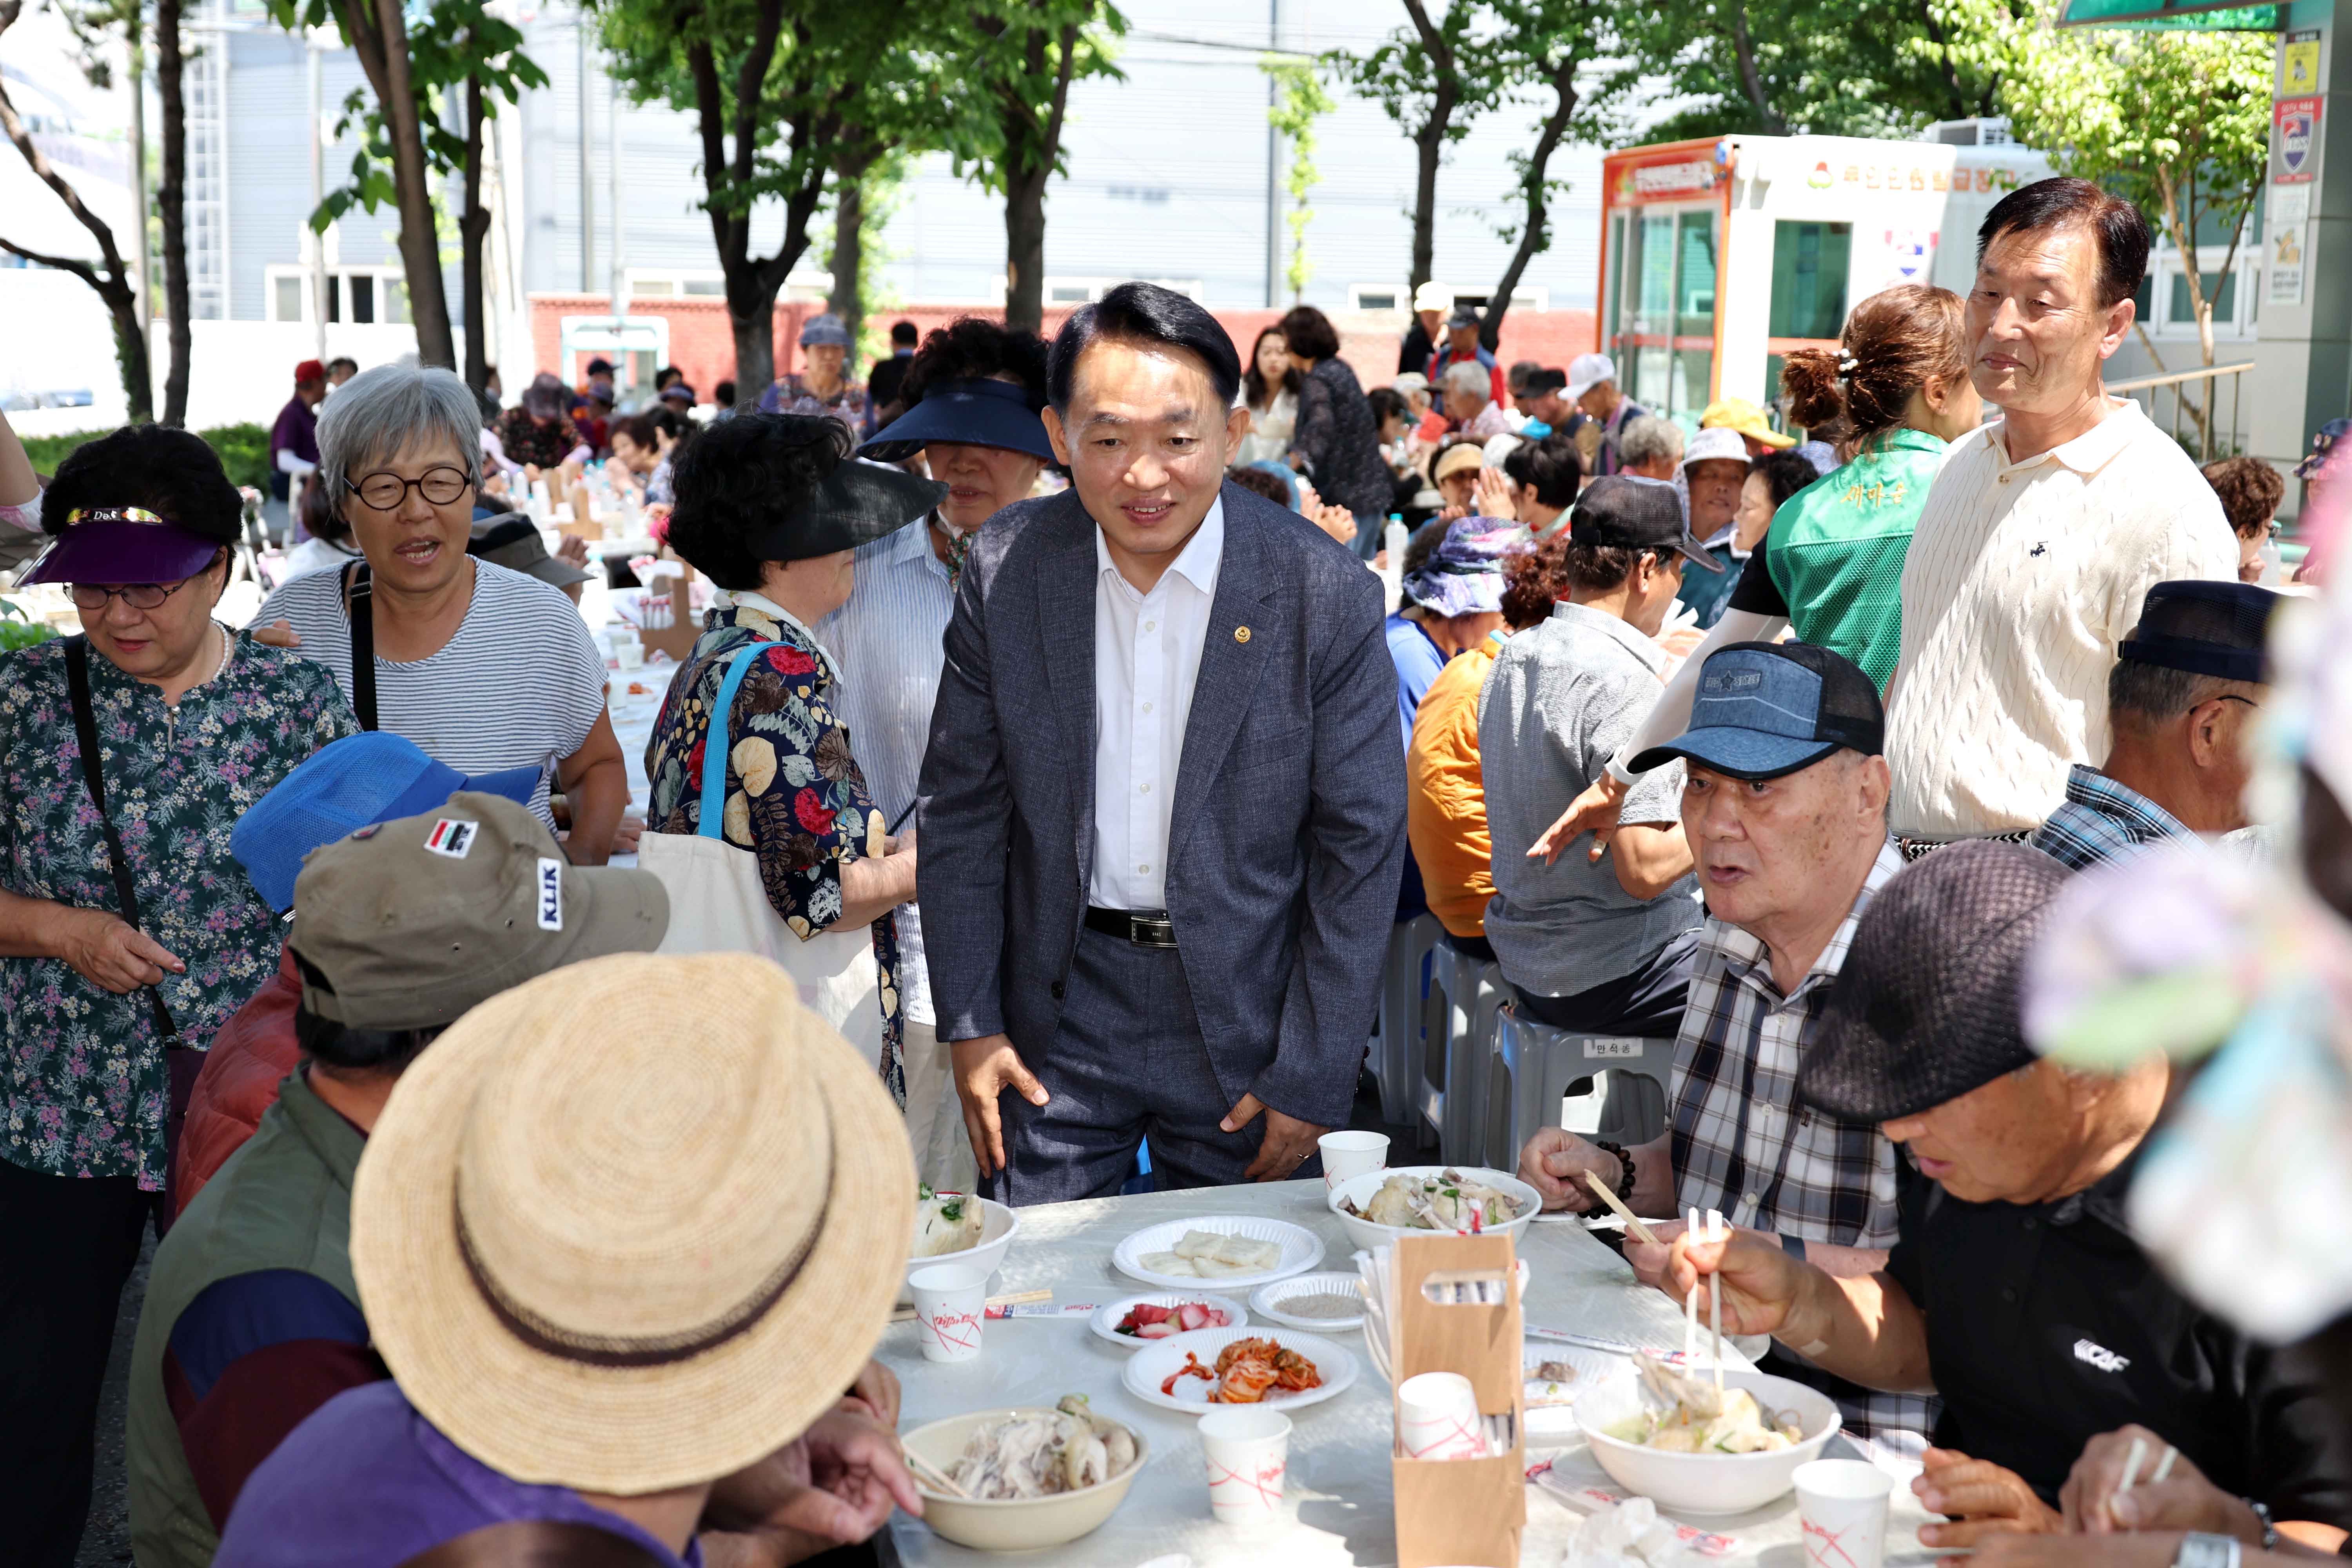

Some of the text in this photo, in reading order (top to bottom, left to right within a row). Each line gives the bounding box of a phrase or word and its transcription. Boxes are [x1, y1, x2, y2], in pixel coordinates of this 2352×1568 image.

[1840, 481, 1908, 508] 새마을
[543, 866, 557, 922] KLIK
[1597, 1043, 1630, 1054] 만석동
